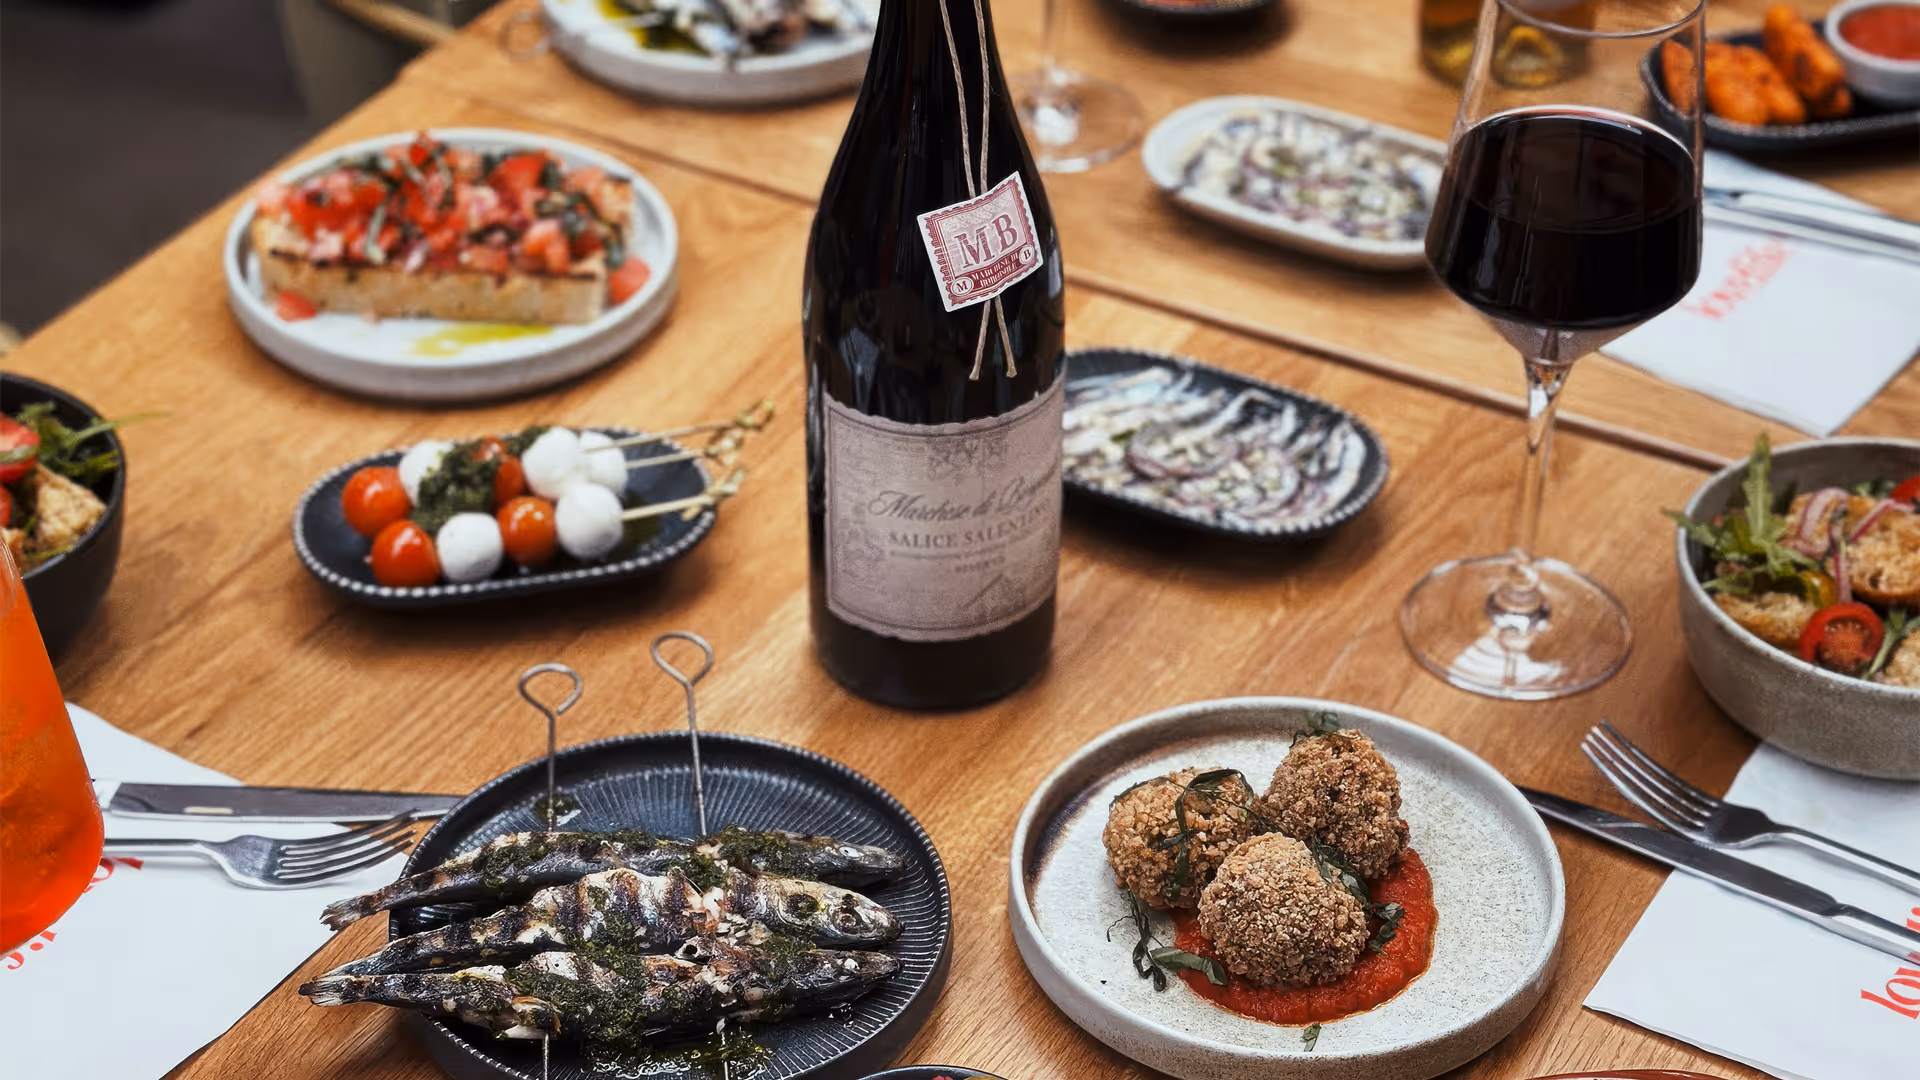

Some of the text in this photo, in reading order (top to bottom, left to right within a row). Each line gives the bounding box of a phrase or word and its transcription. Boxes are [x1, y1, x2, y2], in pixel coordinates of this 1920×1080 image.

[1022, 249, 1031, 260] B
[956, 281, 969, 293] M
[887, 532, 959, 550] SALICE
